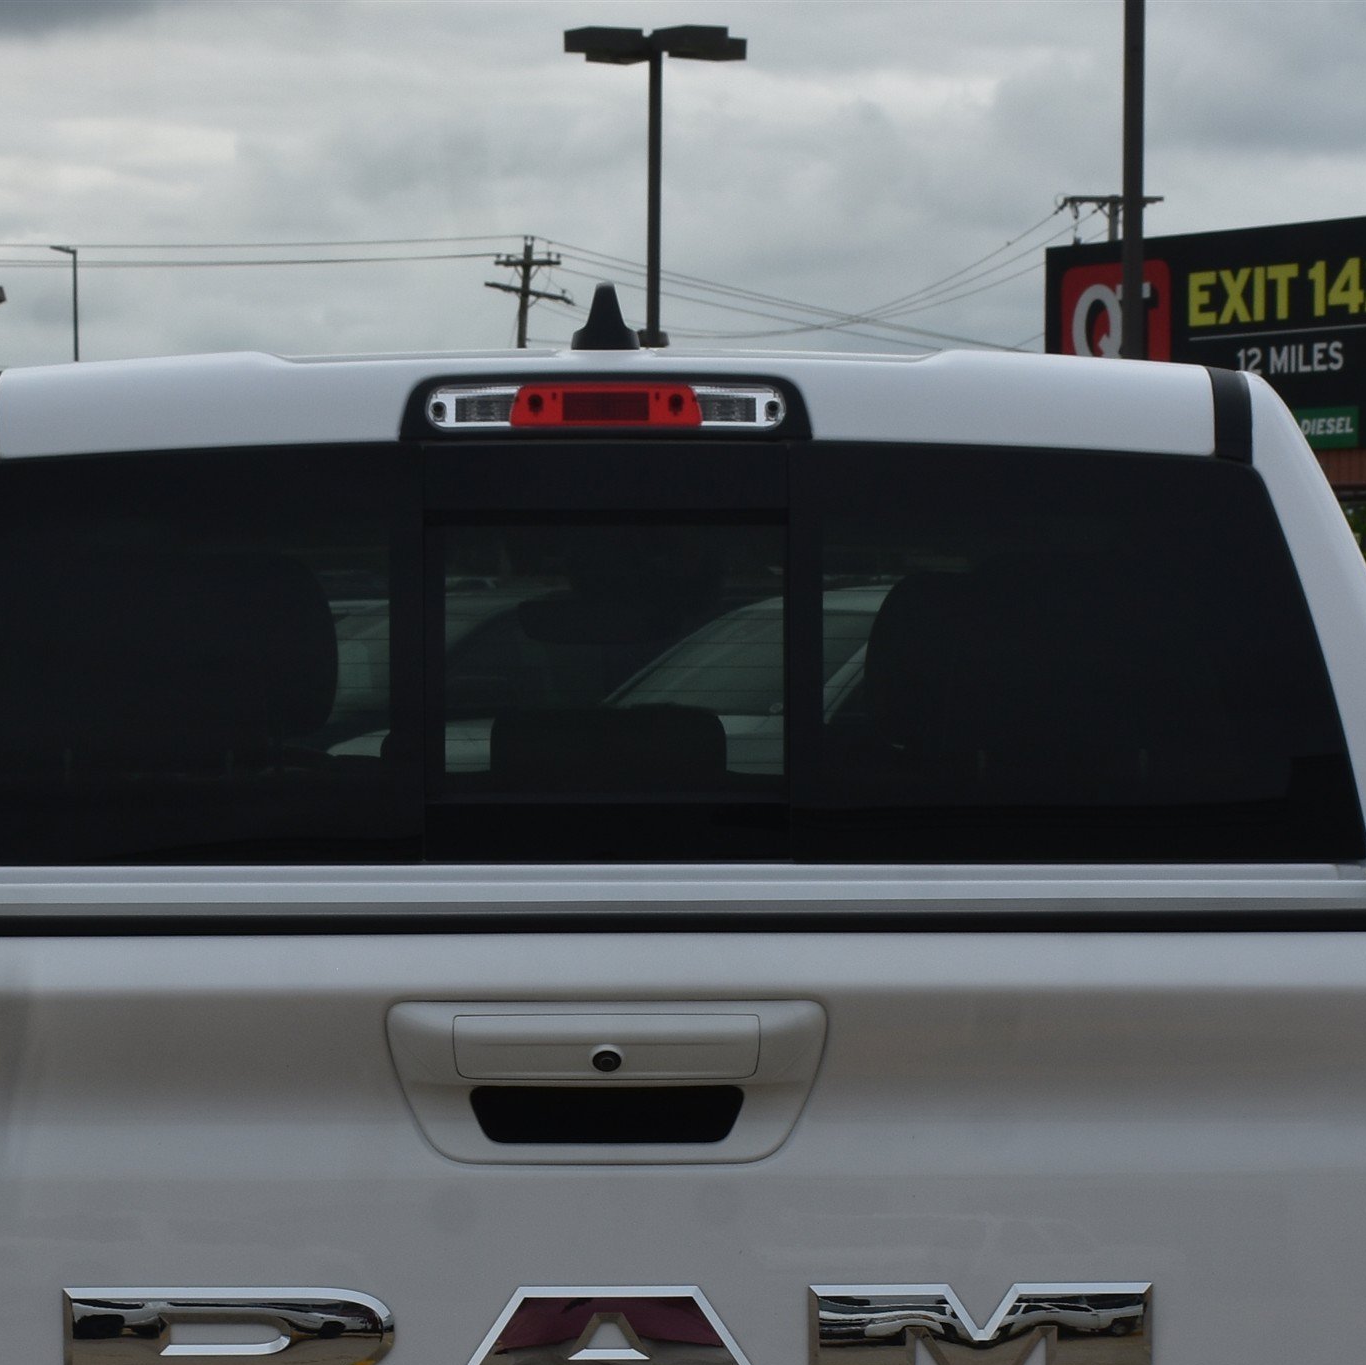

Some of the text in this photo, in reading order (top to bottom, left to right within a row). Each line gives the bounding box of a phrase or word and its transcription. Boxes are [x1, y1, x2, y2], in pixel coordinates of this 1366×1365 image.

[1188, 263, 1299, 328] EXIT
[1237, 341, 1345, 375] 12 MILES
[1300, 416, 1355, 436] DIESEL
